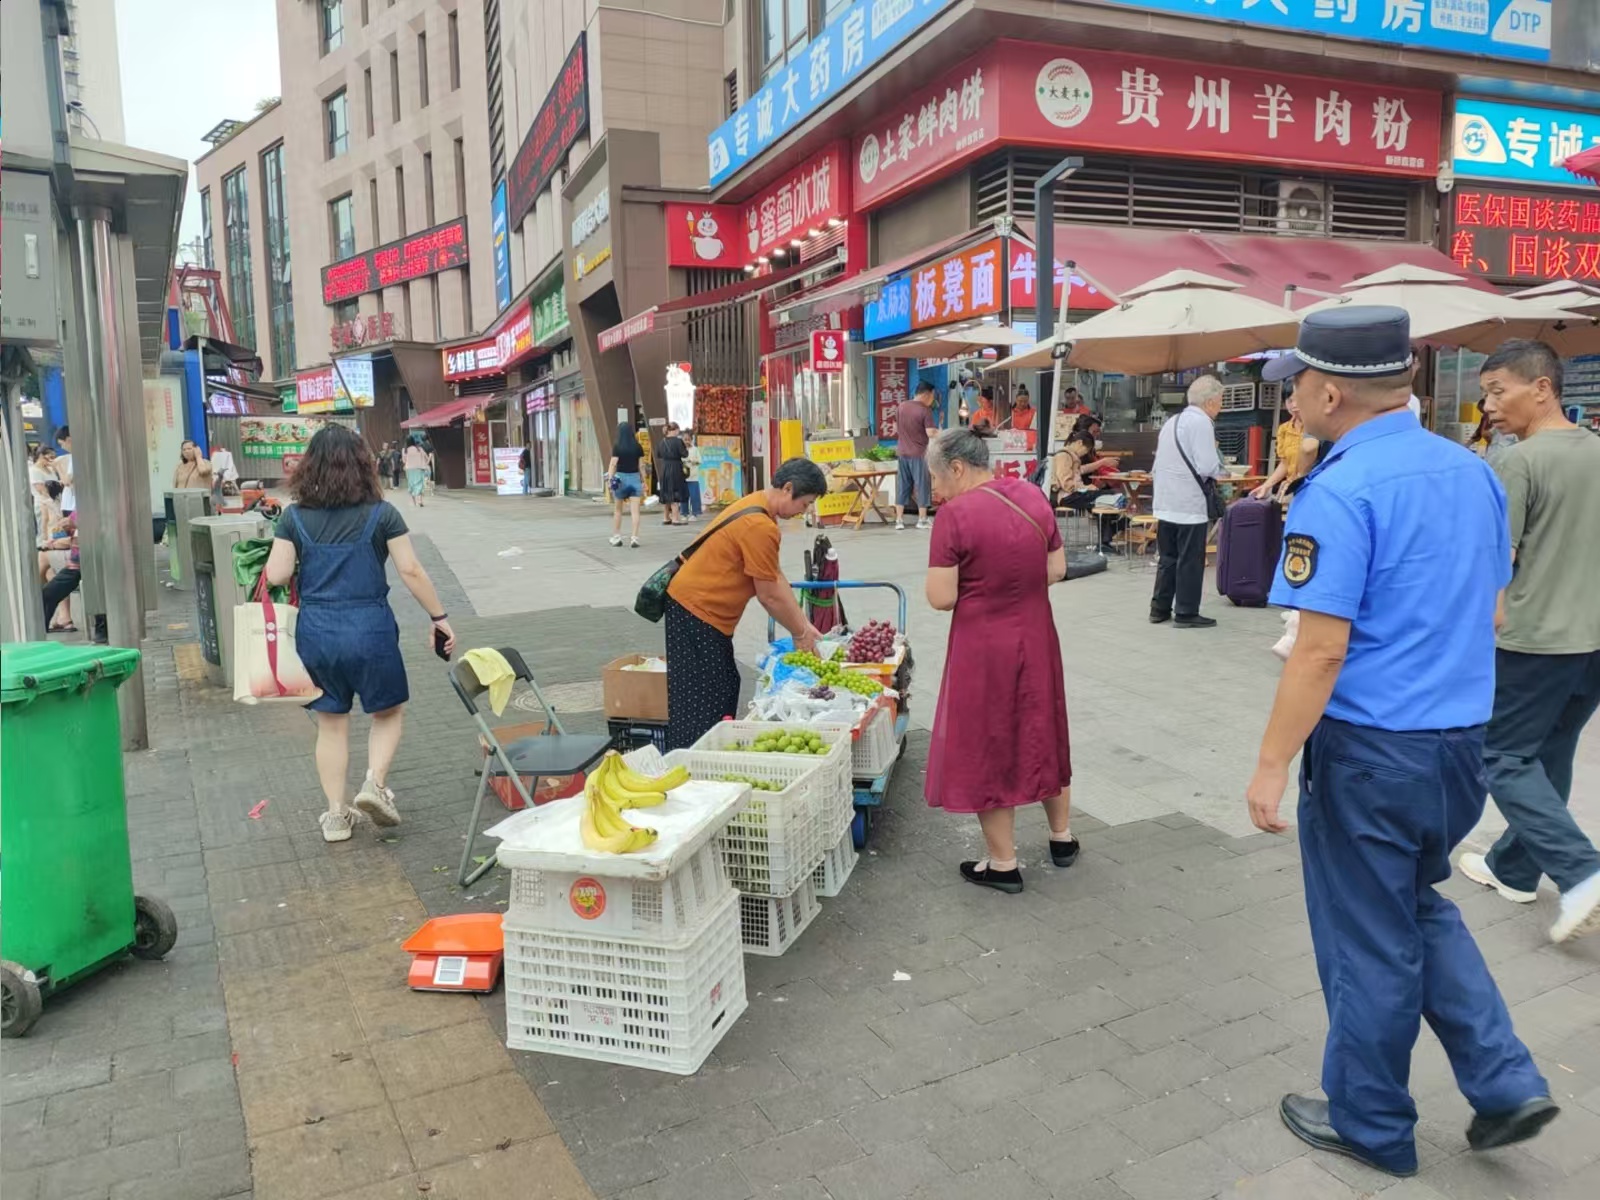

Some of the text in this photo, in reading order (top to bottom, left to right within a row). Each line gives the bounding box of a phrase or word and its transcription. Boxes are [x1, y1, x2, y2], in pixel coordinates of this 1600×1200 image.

[1508, 9, 1541, 33] DTP
[734, 5, 865, 157] 专诚大药房
[880, 67, 985, 171] 土家鲜肉饼
[1116, 67, 1412, 151] 贵州羊肉粉
[1506, 117, 1600, 167] 专诚
[761, 156, 831, 247] 蜜雪冰城
[914, 249, 996, 323] 板凳面
